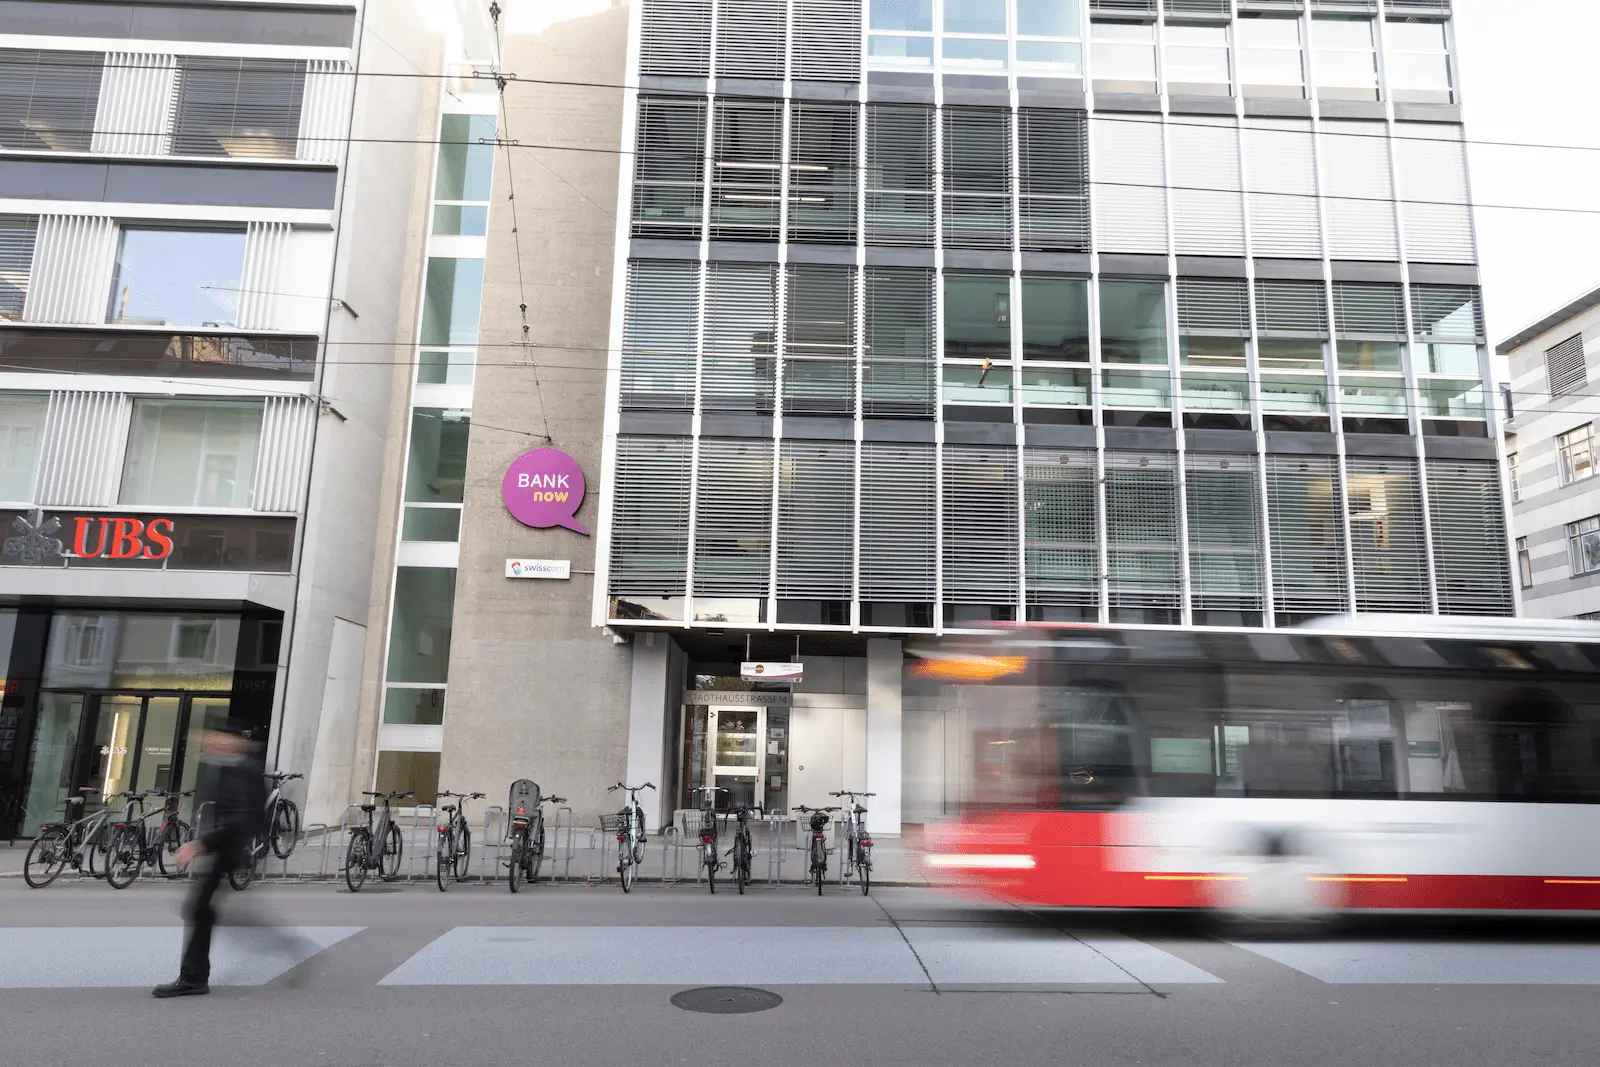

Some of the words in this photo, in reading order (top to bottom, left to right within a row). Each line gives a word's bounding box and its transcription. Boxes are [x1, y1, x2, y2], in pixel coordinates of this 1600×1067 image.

[518, 473, 570, 488] BANK
[533, 491, 569, 503] now
[73, 516, 174, 560] UBS
[524, 563, 565, 573] swisscom
[687, 693, 777, 704] STADTHAUSSTRASSE
[779, 696, 787, 704] 14
